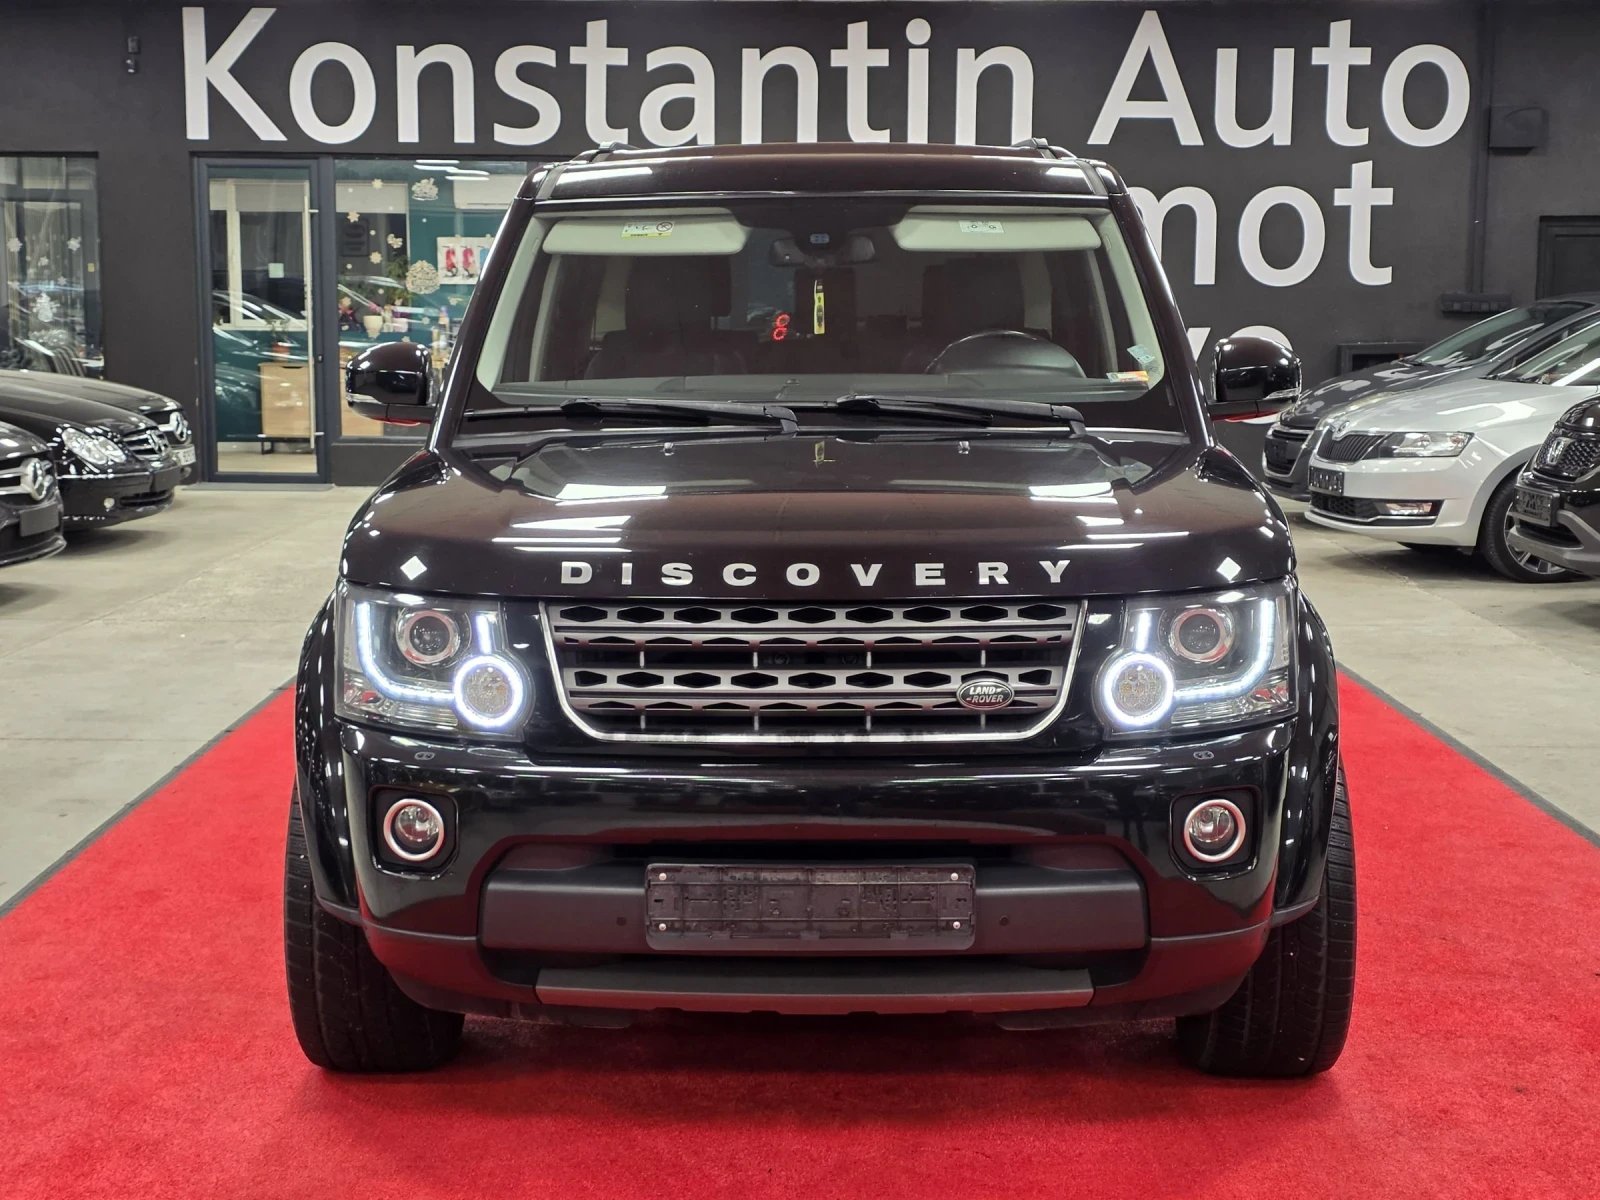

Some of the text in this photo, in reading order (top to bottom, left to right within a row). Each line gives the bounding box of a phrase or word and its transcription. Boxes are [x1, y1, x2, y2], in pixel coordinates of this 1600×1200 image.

[182, 7, 1470, 149] Konstantin Auto
[560, 559, 1071, 587] DISCOVERY
[969, 686, 996, 695] LAND
[971, 694, 1004, 704] ROVER
